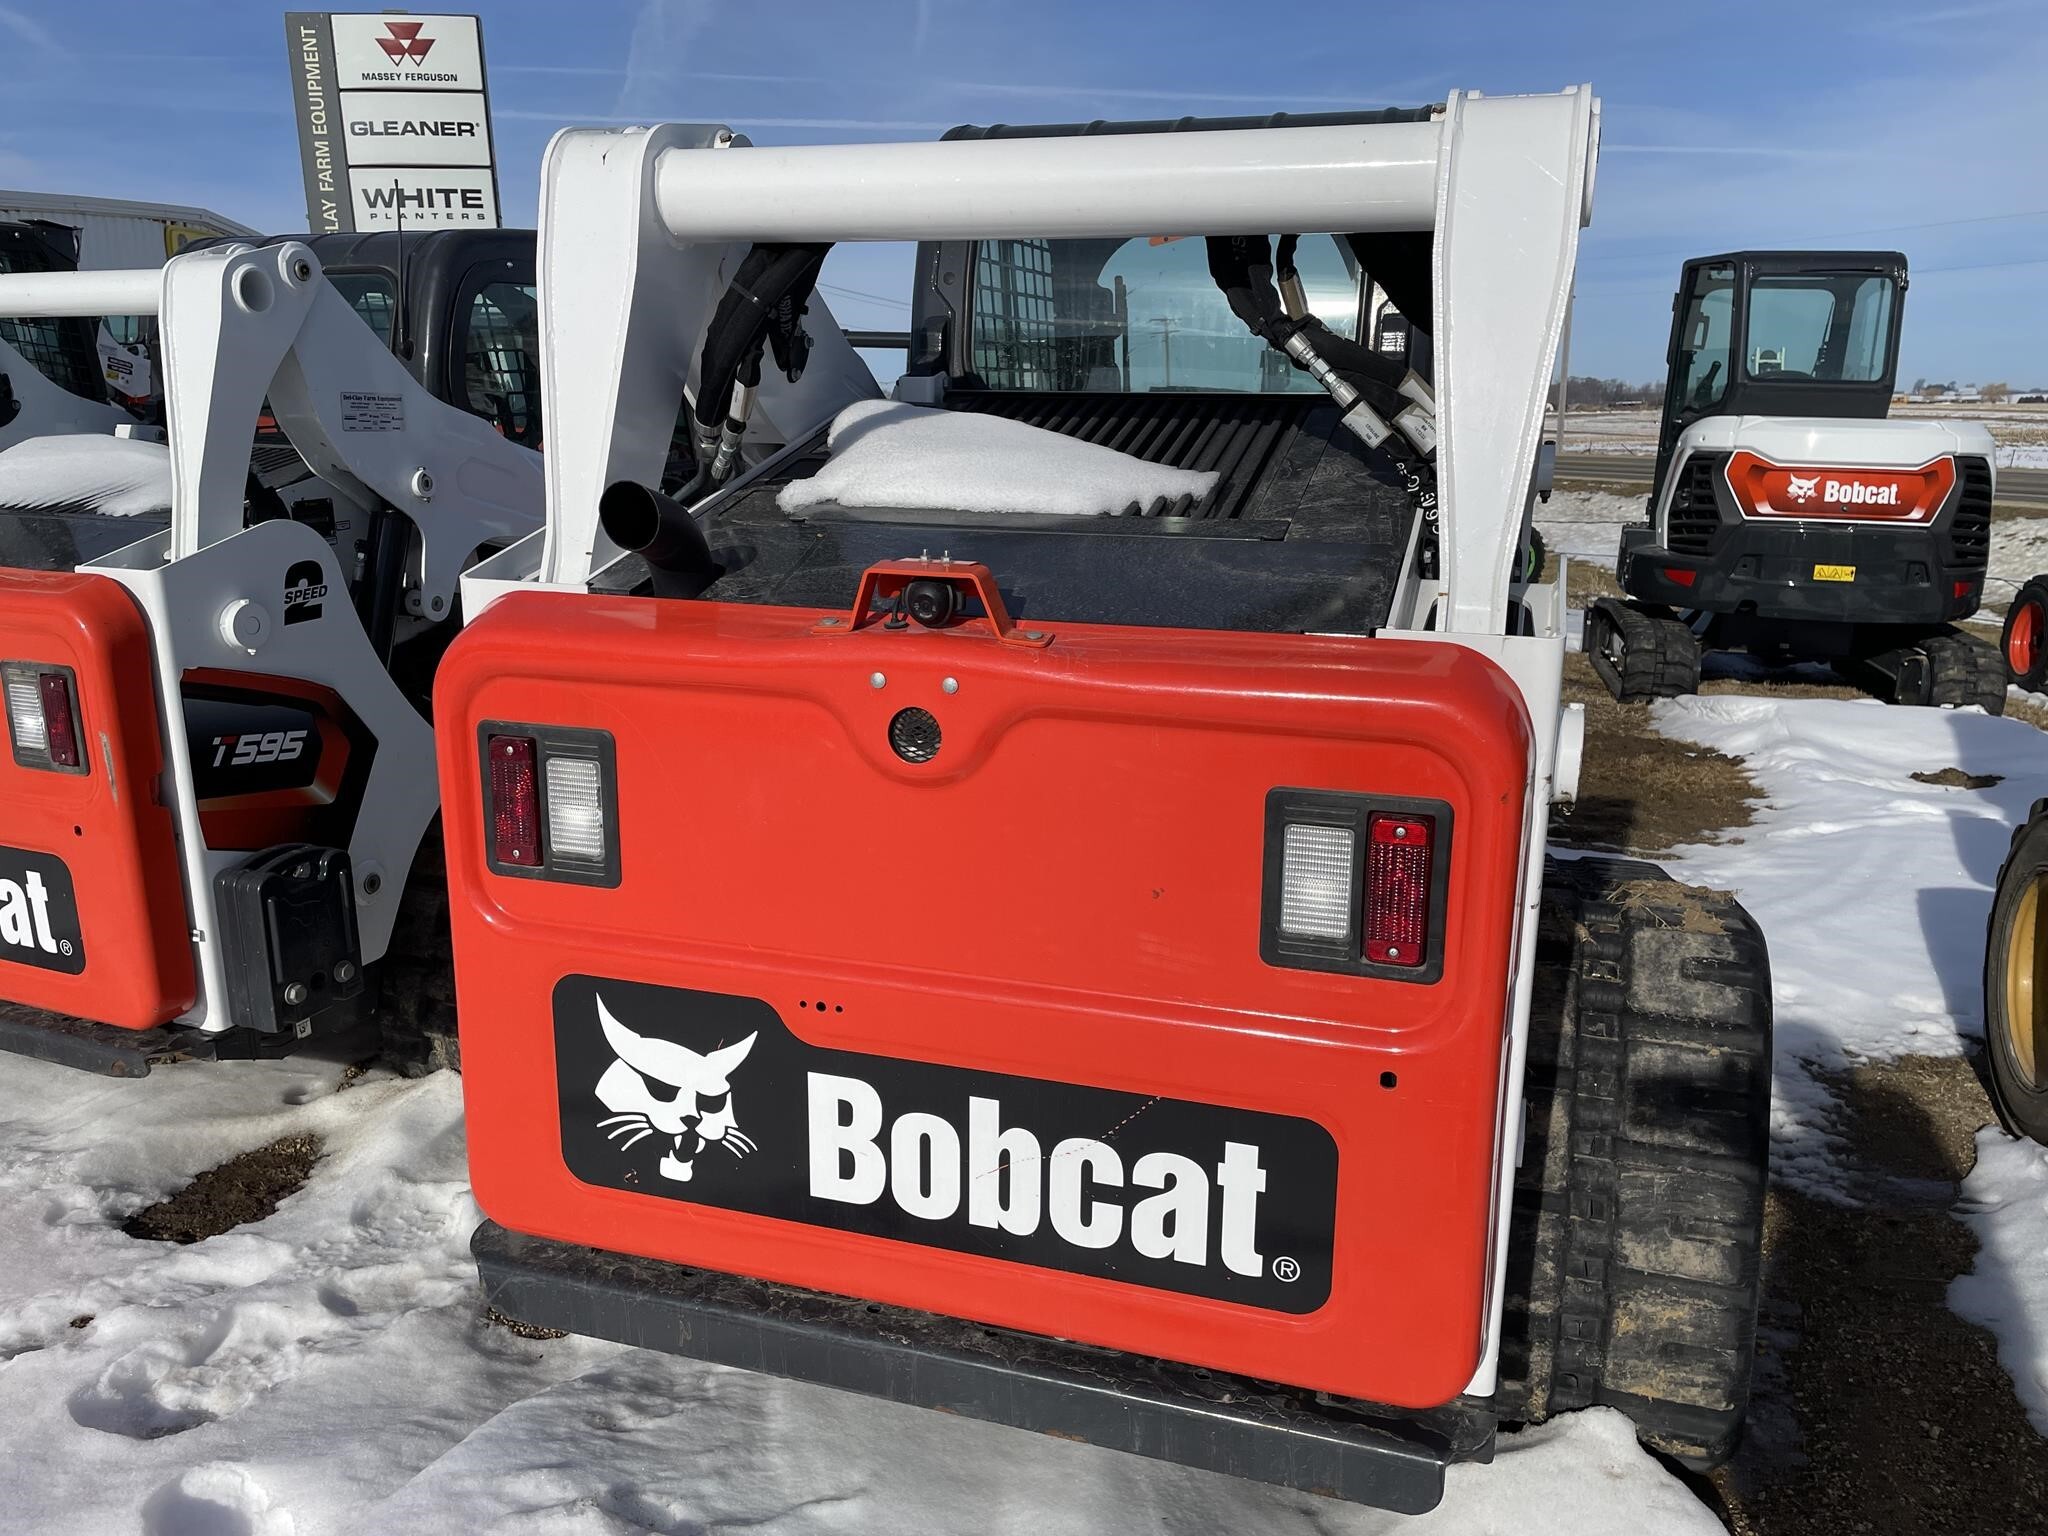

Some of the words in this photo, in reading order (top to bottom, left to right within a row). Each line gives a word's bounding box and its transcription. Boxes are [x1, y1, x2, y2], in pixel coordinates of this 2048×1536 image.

[300, 26, 328, 135] EQUIPMENT
[361, 72, 402, 81] MASSEY
[405, 73, 458, 82] FERGUSON
[314, 141, 335, 191] FARM
[361, 187, 484, 209] WHITE
[322, 199, 339, 233] LAY
[370, 212, 486, 220] PLANTERS
[1823, 480, 1898, 505] Bobcat
[284, 584, 328, 604] SPEED
[212, 730, 308, 768] T595
[807, 1071, 1267, 1279] Bobcat
